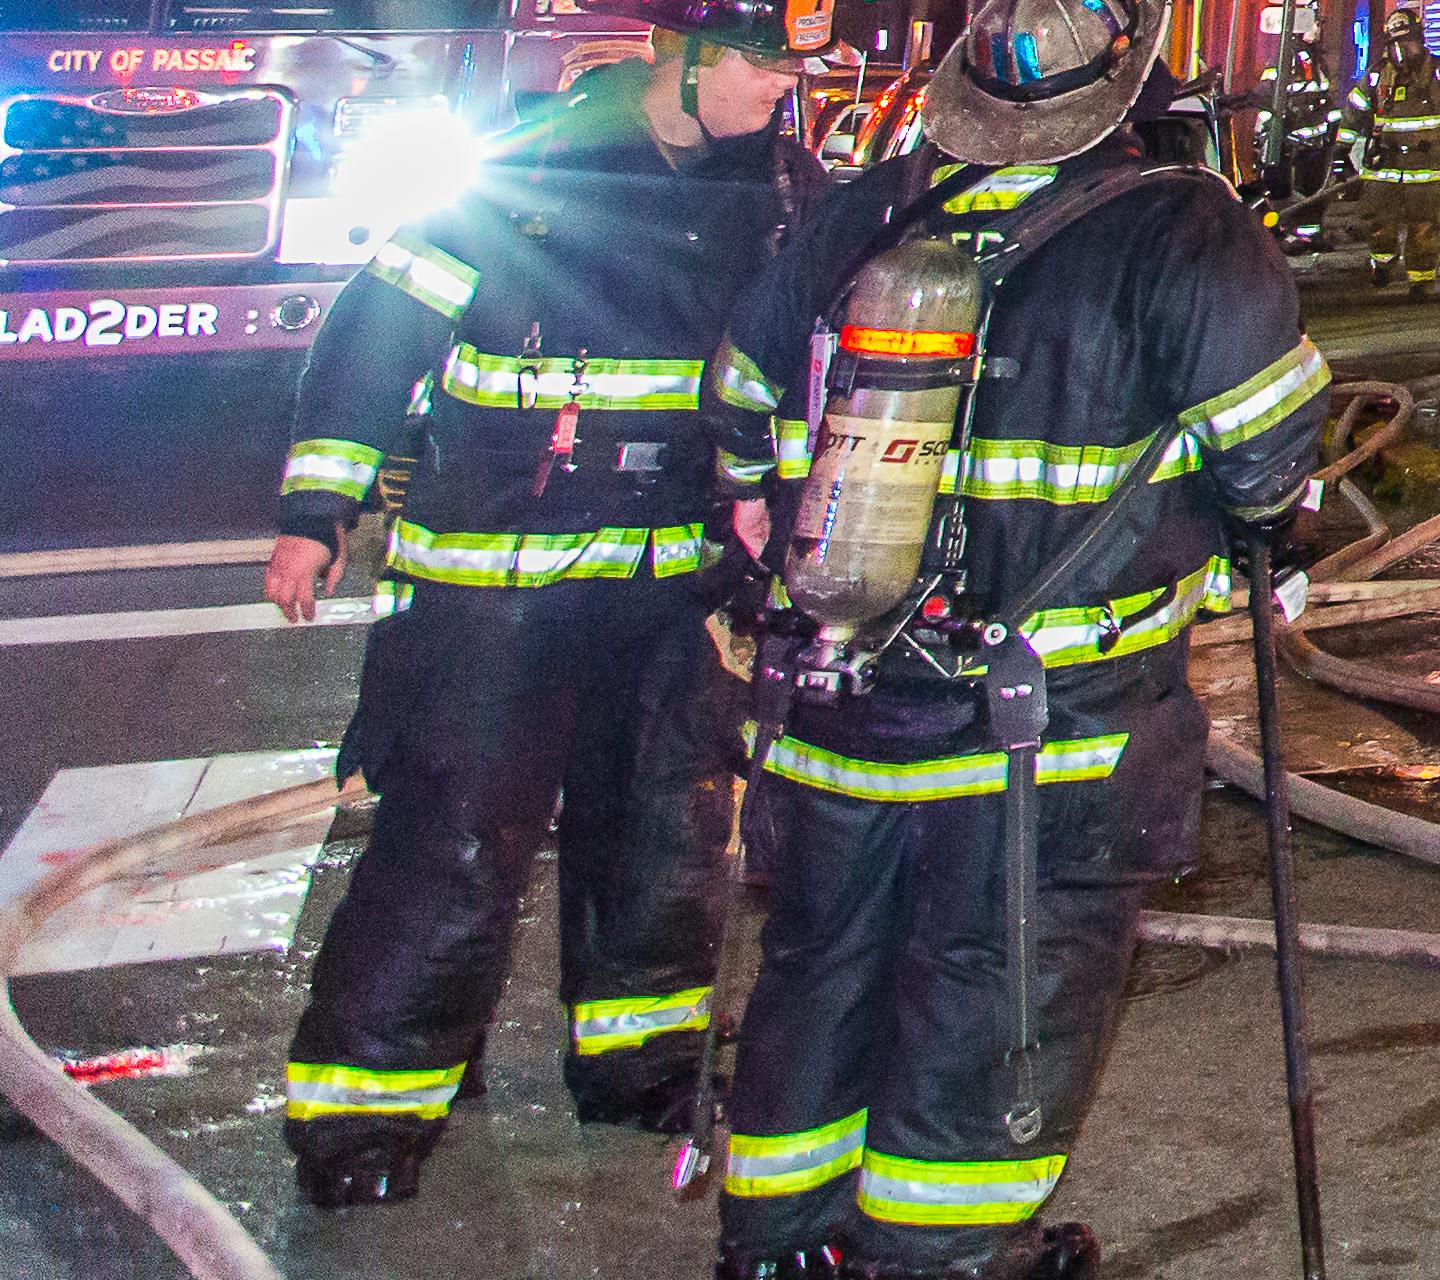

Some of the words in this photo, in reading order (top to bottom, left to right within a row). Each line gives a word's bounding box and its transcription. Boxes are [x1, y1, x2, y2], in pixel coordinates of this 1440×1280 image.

[48, 50, 103, 73] CITY
[110, 49, 145, 71] OF
[151, 47, 256, 72] PASSAIC
[0, 299, 219, 346] LAD2DER
[829, 434, 867, 452] OTT
